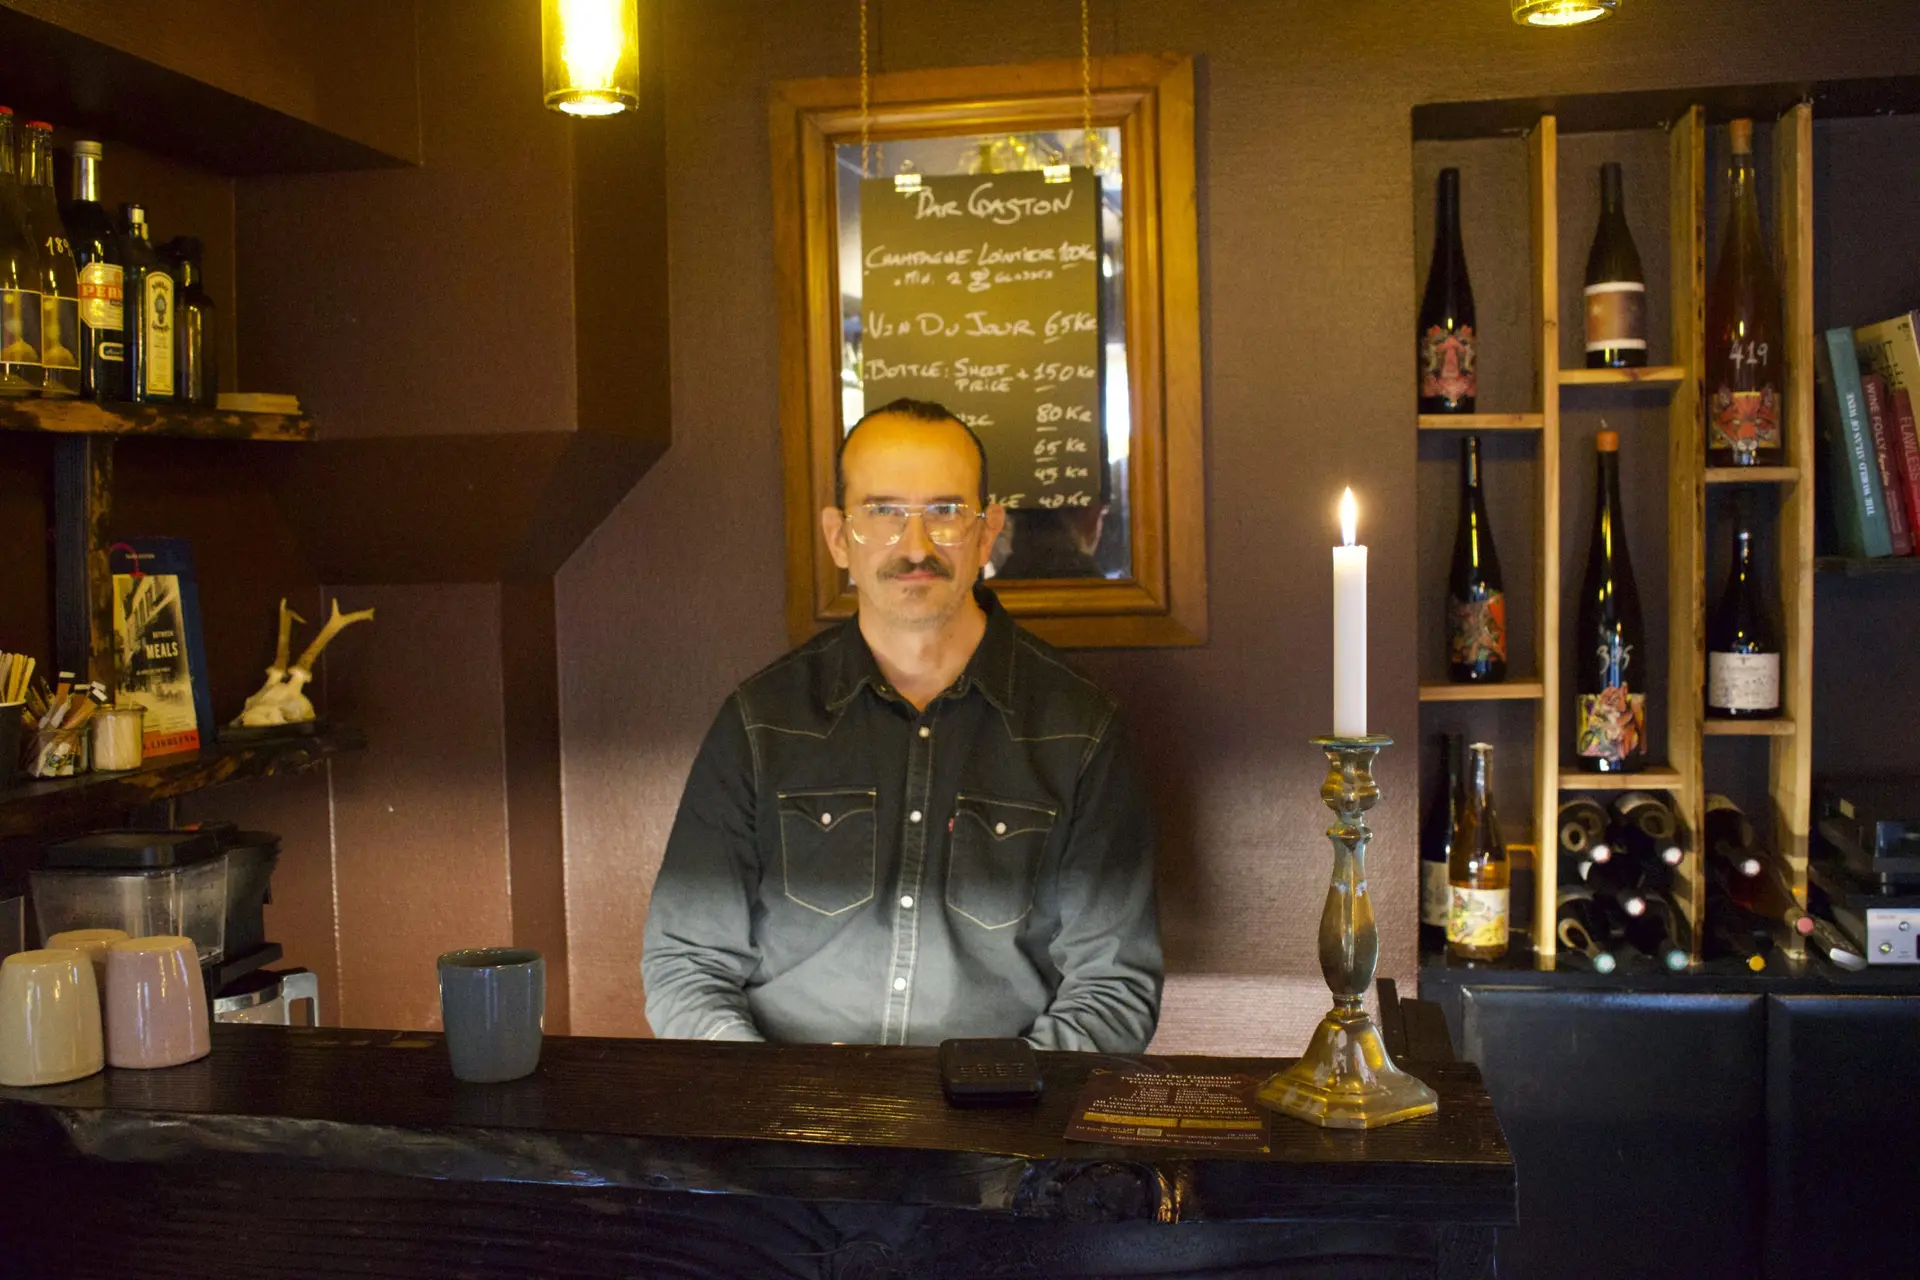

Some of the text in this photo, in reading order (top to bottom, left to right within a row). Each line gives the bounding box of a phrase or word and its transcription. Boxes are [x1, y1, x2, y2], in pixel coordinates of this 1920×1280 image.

[968, 182, 1074, 225] GASTON
[865, 245, 973, 268] CHAMPAGNE
[82, 286, 123, 299] PER
[965, 311, 1035, 336] JOUR
[1729, 340, 1769, 369] 419
[1866, 383, 1880, 413] WINE
[1873, 416, 1887, 450] FOLLY
[1900, 416, 1920, 482] FLAWLESS
[145, 642, 179, 660] MEALS
